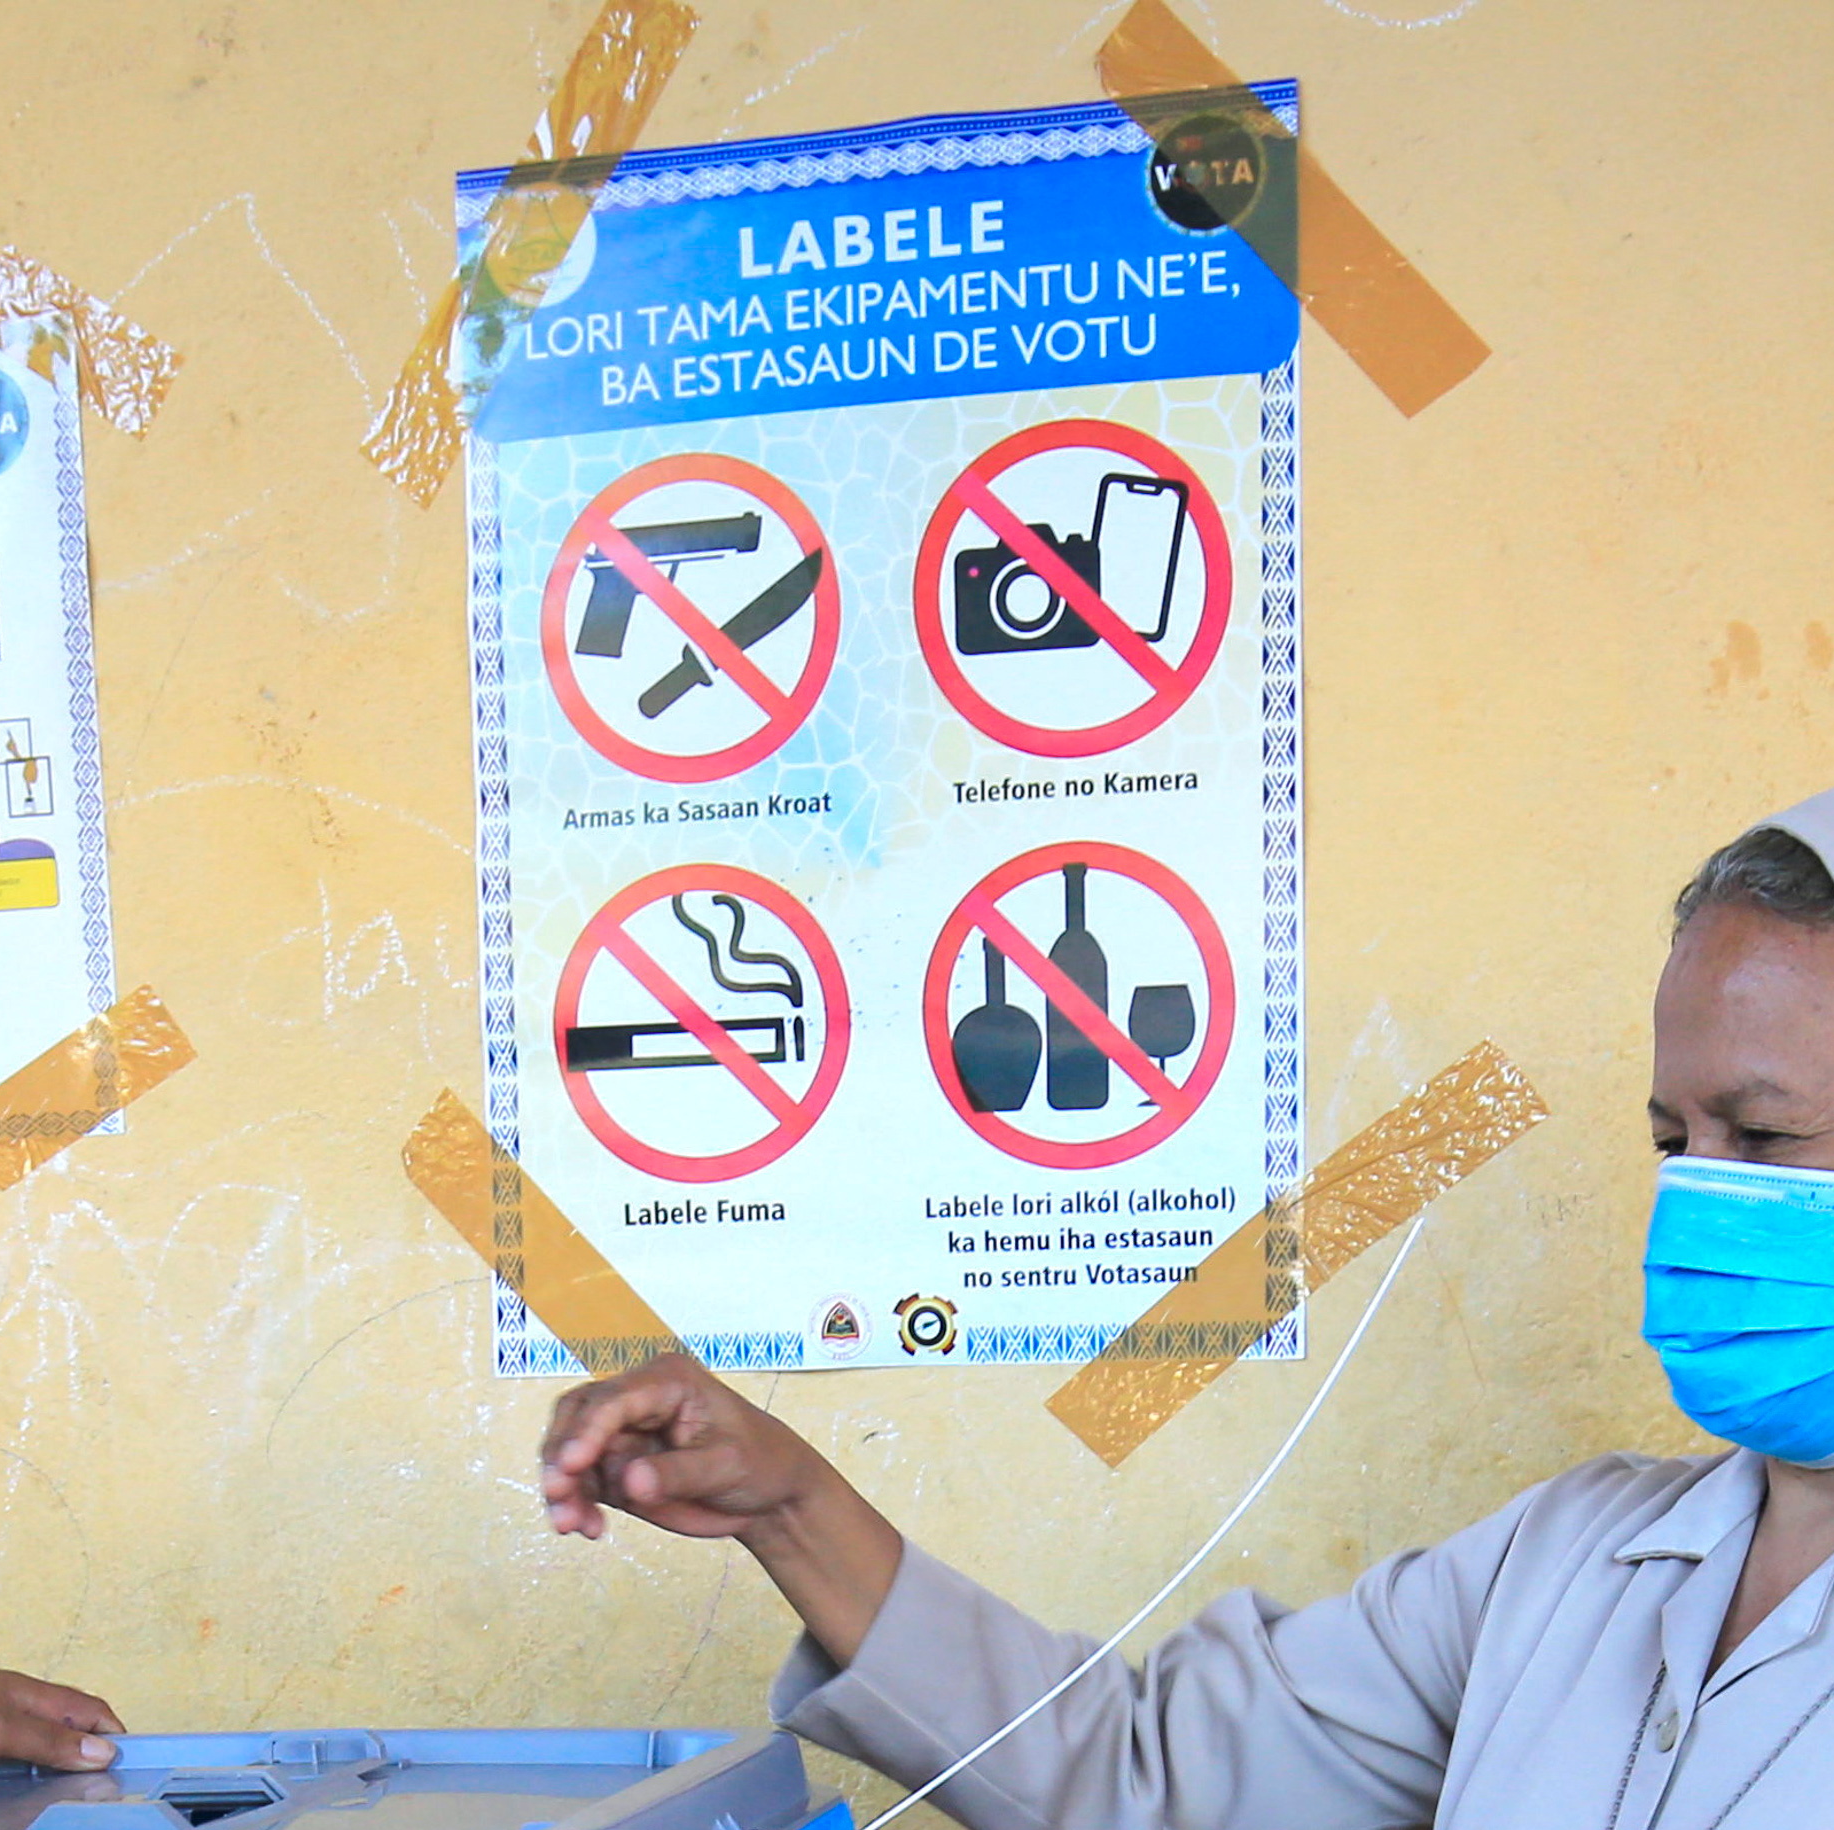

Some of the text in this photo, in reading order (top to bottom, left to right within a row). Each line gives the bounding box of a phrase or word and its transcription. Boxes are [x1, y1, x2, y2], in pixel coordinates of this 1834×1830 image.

[738, 200, 1005, 279] LABELE
[524, 250, 1241, 360] LORI TAMA EKIPAMENTU NE'E,
[601, 313, 1157, 407] BA ESTASAUN DE VOTU
[953, 771, 1199, 804] Telefone no Kamera
[563, 792, 833, 830] Armas ka Sasaan Kroat
[624, 1199, 786, 1226] Labele Fuma
[925, 1186, 1237, 1219] Labele lori alkól (alkohol)
[948, 1227, 1214, 1253] ka hemu iha estasaun
[963, 1262, 1199, 1288] no sentru Votasaun
